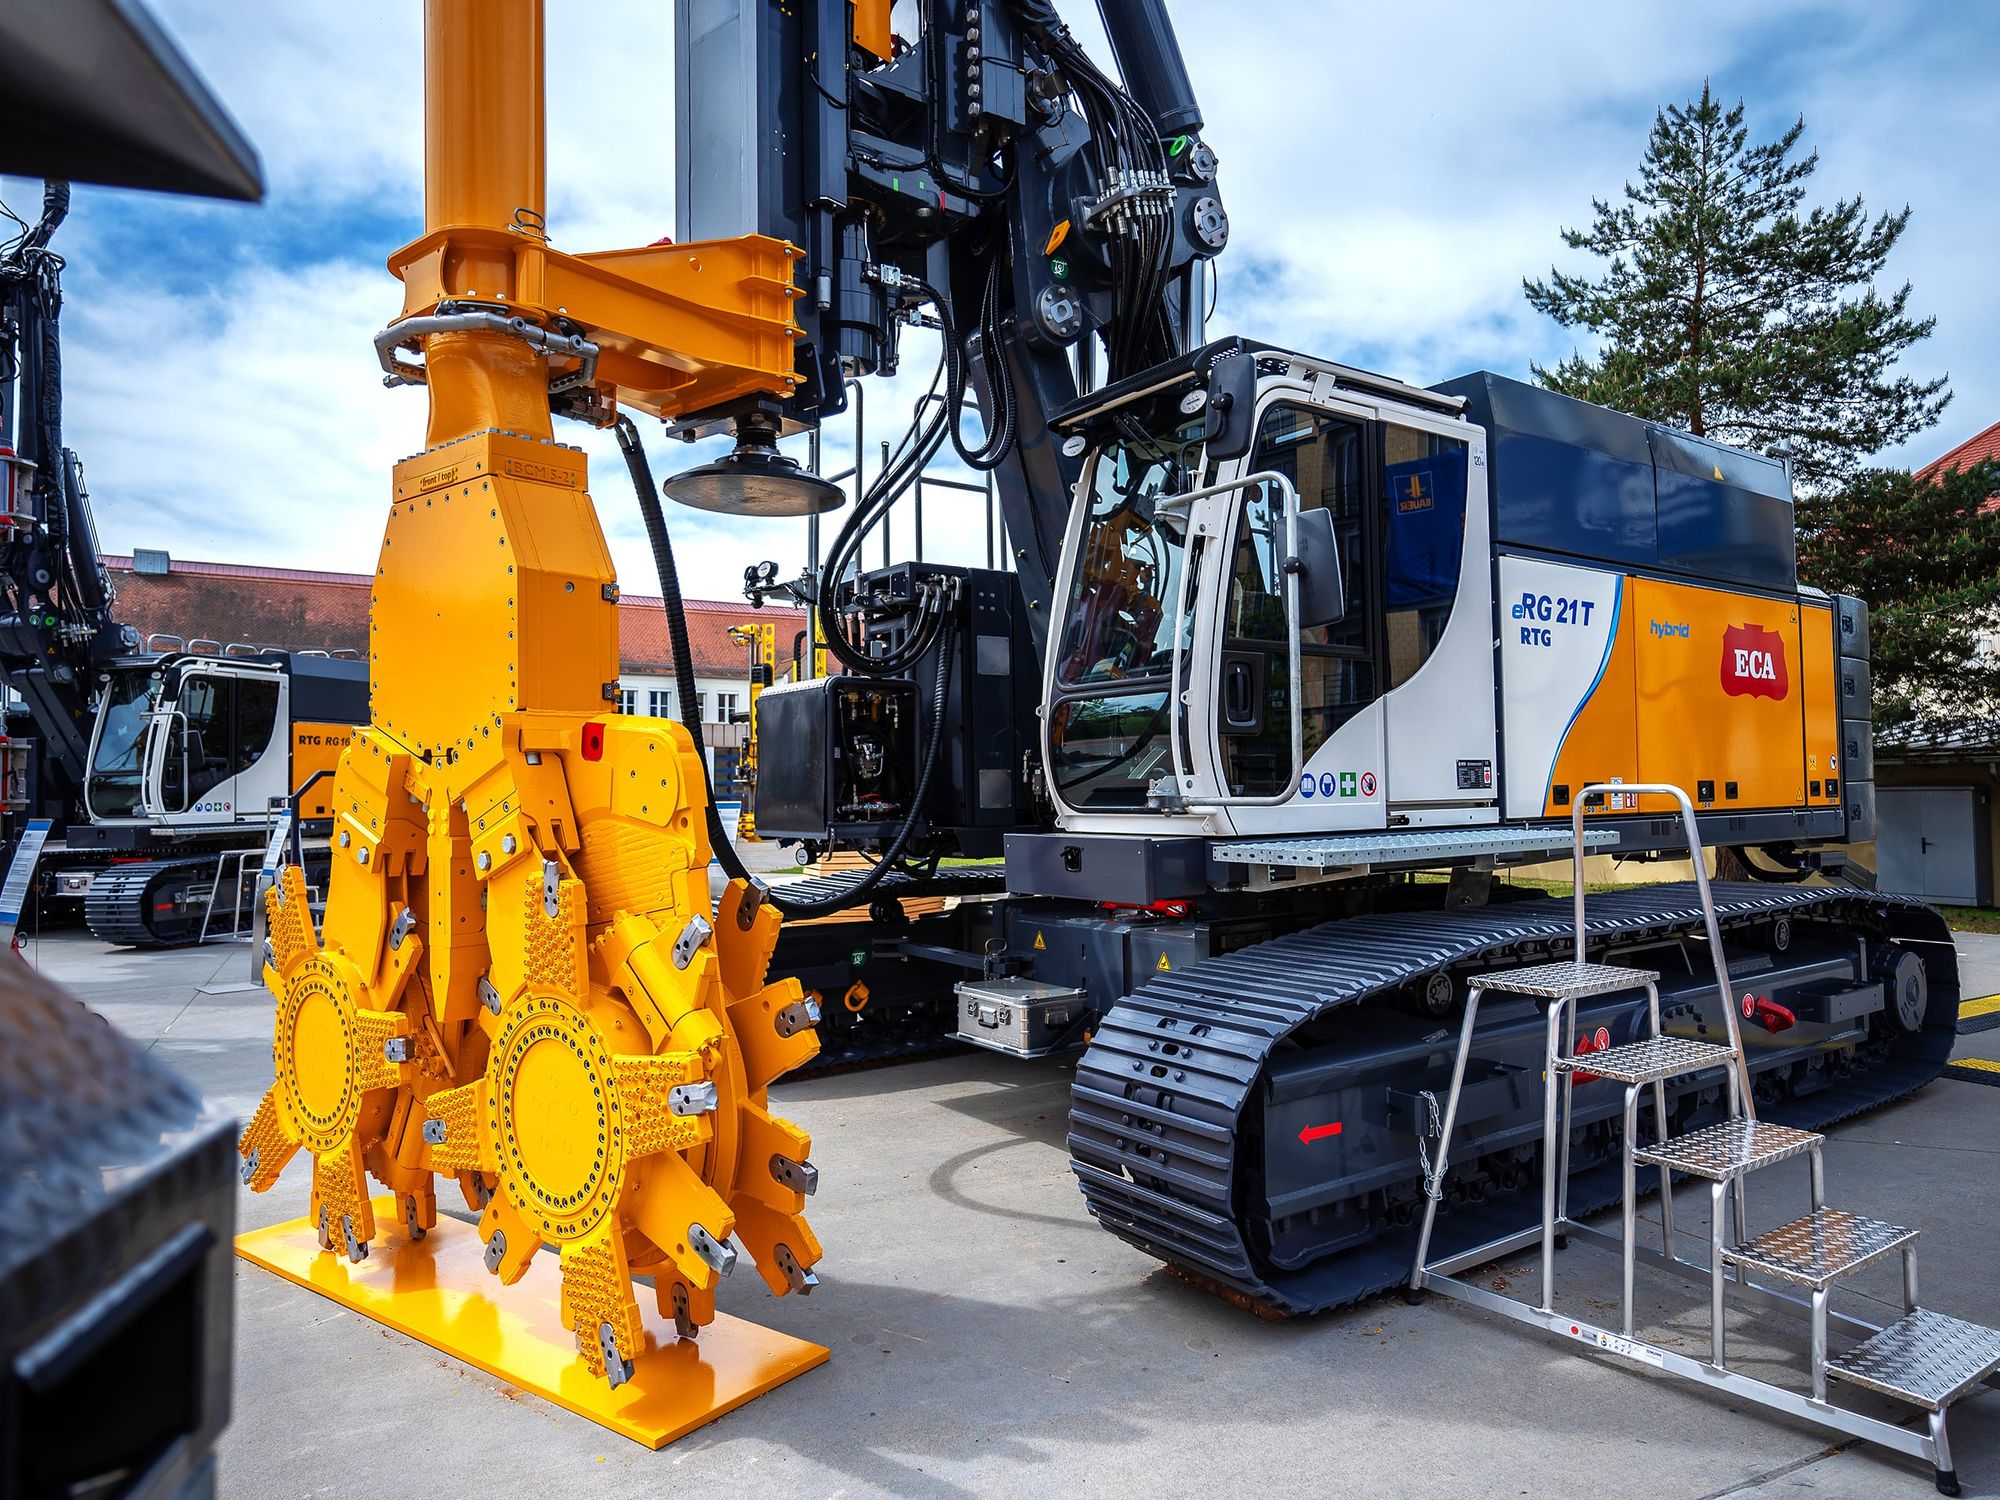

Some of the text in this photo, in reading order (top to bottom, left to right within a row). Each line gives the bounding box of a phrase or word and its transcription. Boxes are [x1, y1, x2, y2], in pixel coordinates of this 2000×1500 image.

[422, 475, 437, 487] front
[441, 471, 452, 481] top
[514, 461, 546, 478] BCM
[1511, 593, 1553, 622] eRG
[1520, 627, 1551, 647] RTG
[1650, 619, 1690, 639] hybrid
[1734, 648, 1777, 680] ECA
[298, 735, 321, 746] RTG
